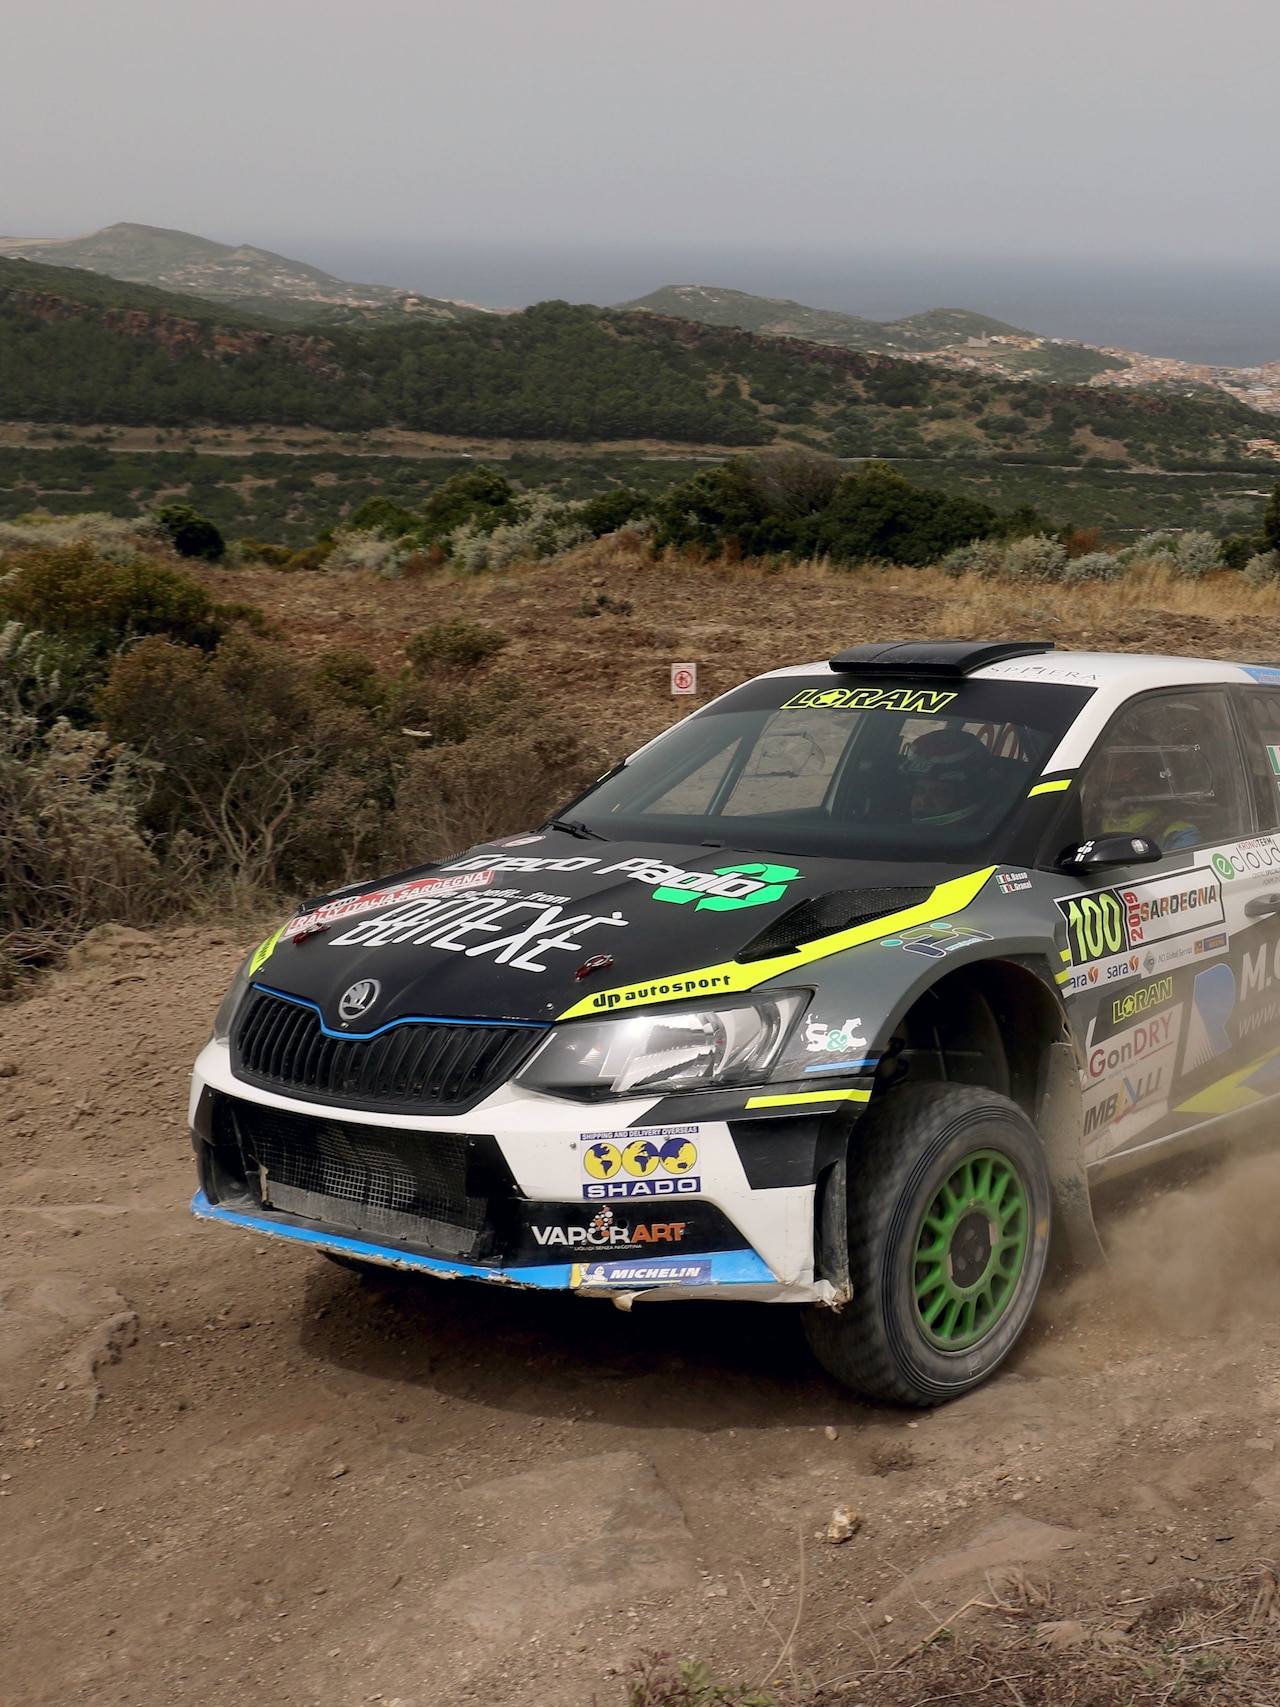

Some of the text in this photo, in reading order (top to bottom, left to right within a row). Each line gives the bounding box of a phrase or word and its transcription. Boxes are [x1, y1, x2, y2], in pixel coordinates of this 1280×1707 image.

[780, 687, 958, 714] LORAN
[399, 871, 485, 898] SARDEGNA
[593, 857, 766, 897] Paolo
[1123, 891, 1144, 942] 2019
[1140, 885, 1217, 922] SARDEGNA
[1069, 893, 1122, 962] 100
[1070, 962, 1129, 989] ara sara
[593, 975, 731, 1008] dp autosport
[1112, 976, 1173, 1024] LORAN
[1089, 1012, 1173, 1078] GonDRY
[581, 1126, 698, 1141] SHIPPING AND DELIVERY OVERSEAS
[587, 1178, 698, 1199] SHADO
[531, 1222, 687, 1246] VAPORART
[610, 1266, 701, 1279] MICHELIN
